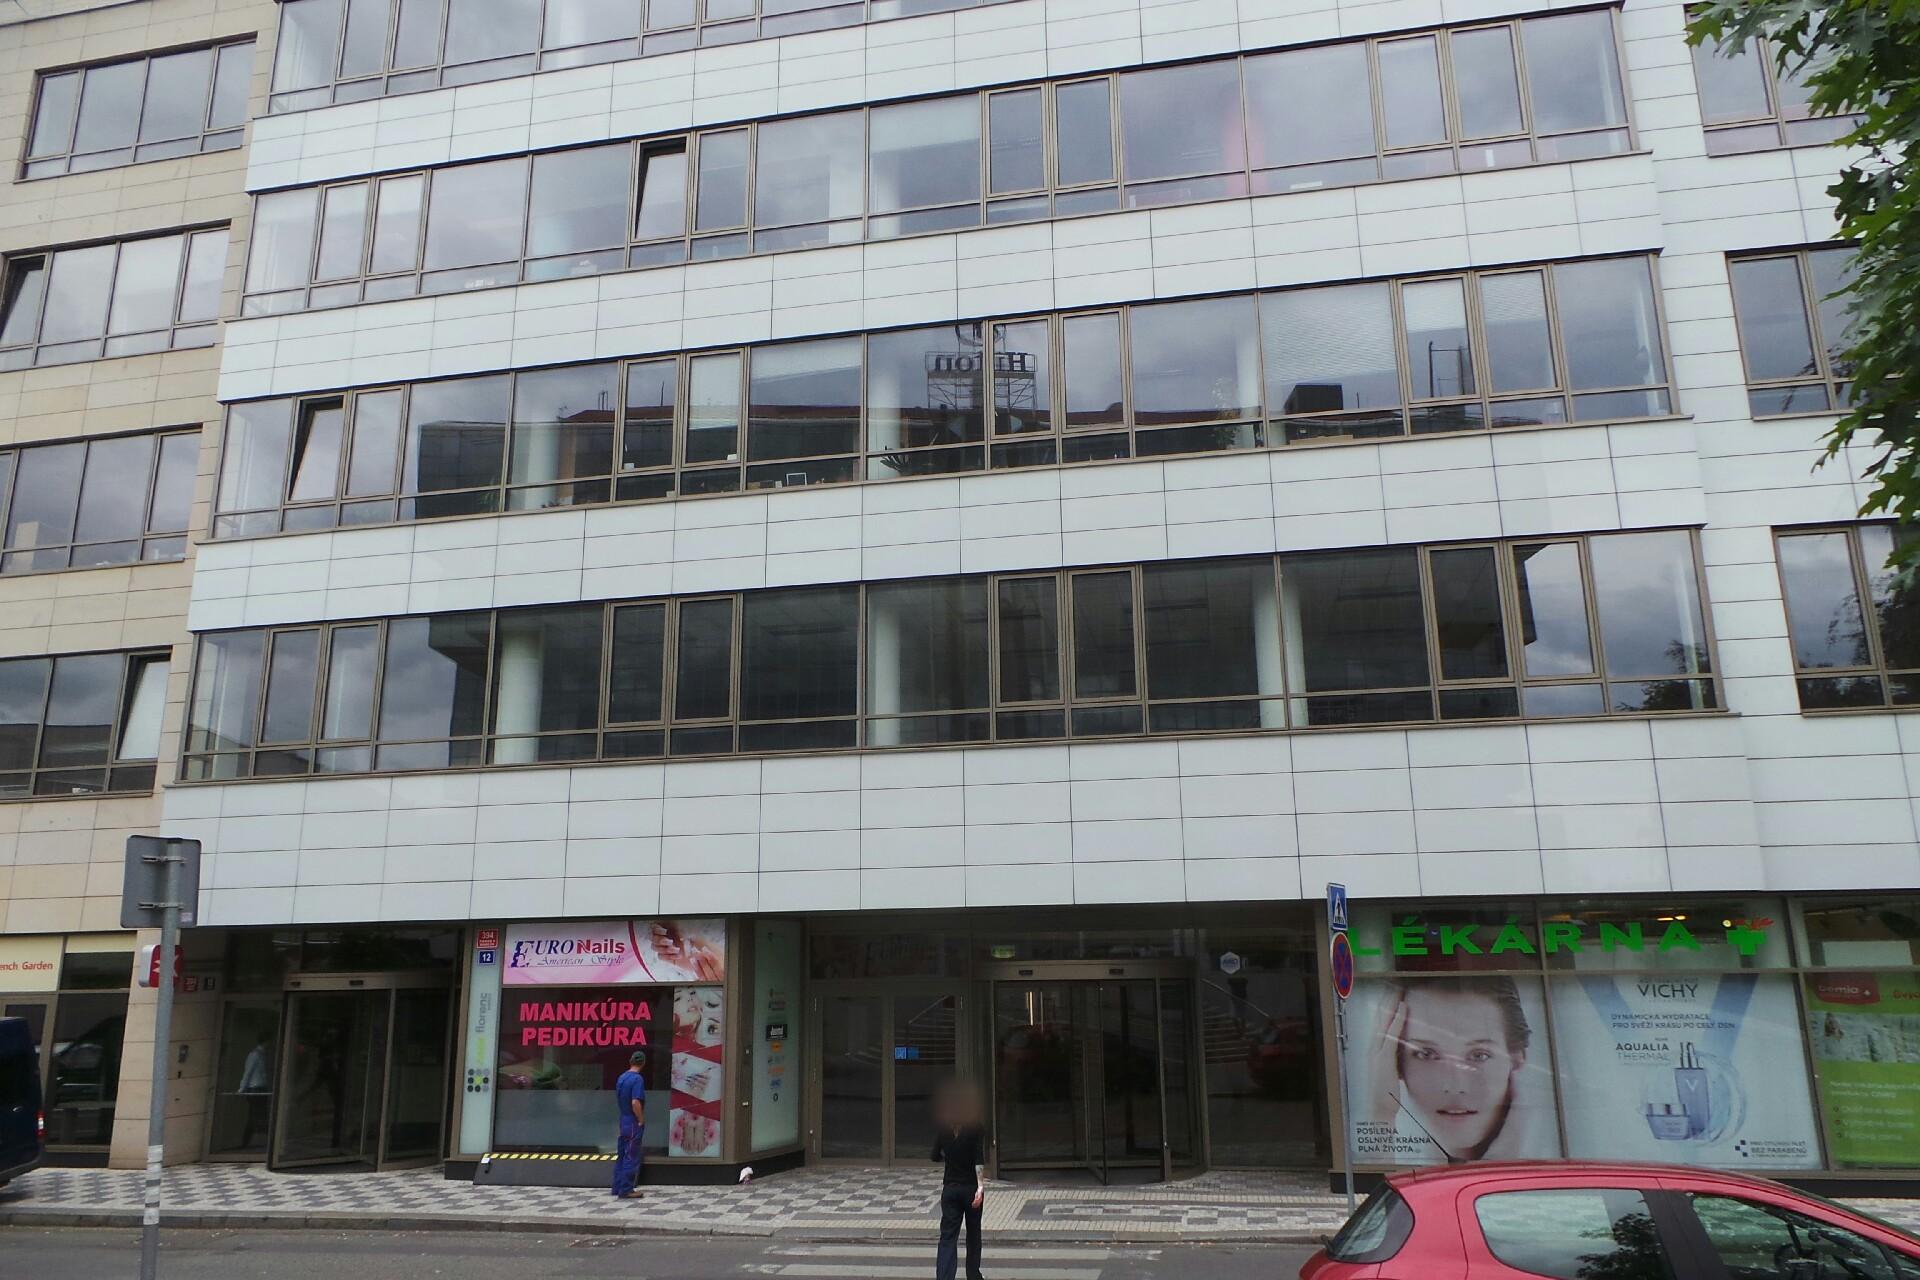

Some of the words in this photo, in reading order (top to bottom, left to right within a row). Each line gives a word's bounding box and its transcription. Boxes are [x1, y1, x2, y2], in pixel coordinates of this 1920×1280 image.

[1349, 916, 1702, 956] LÉKÁRNA
[576, 939, 625, 954] Nails
[482, 953, 491, 962] 12
[22, 961, 53, 970] Garden
[1637, 984, 1698, 998] VICHY
[520, 998, 651, 1021] MANIKÚRA
[522, 1023, 647, 1046] PEDIKÚRA
[1616, 1043, 1669, 1051] AQUALIA
[1383, 1144, 1414, 1152] ŽIVOTA
